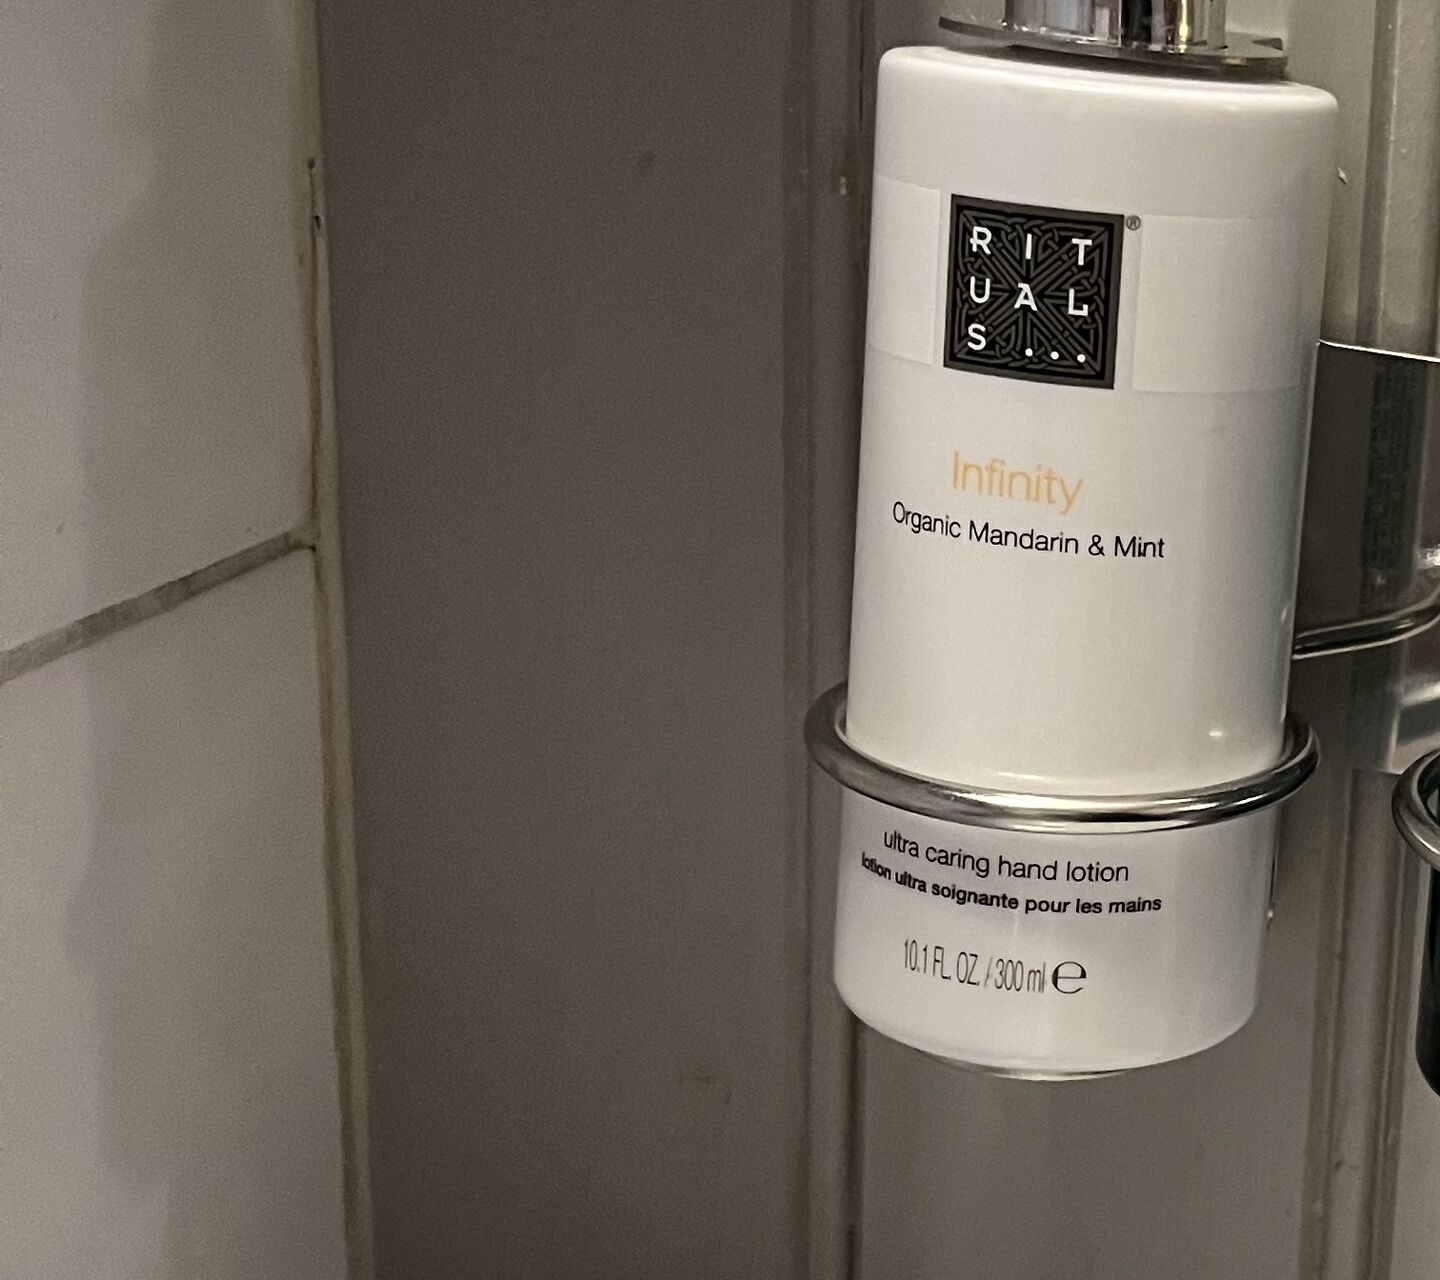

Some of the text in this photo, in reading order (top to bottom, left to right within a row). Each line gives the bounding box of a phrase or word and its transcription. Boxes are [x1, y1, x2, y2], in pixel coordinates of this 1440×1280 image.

[952, 451, 1084, 516] Infinity
[892, 501, 1165, 558] Organic Mandarin & Mint
[861, 852, 1162, 915] lotion ultra soignante pour les mains
[884, 830, 1130, 883] ultra caring hand lotion
[903, 938, 929, 974] 10.1
[983, 956, 993, 989] /
[995, 958, 1024, 992] 300
[1027, 961, 1047, 994] ml
